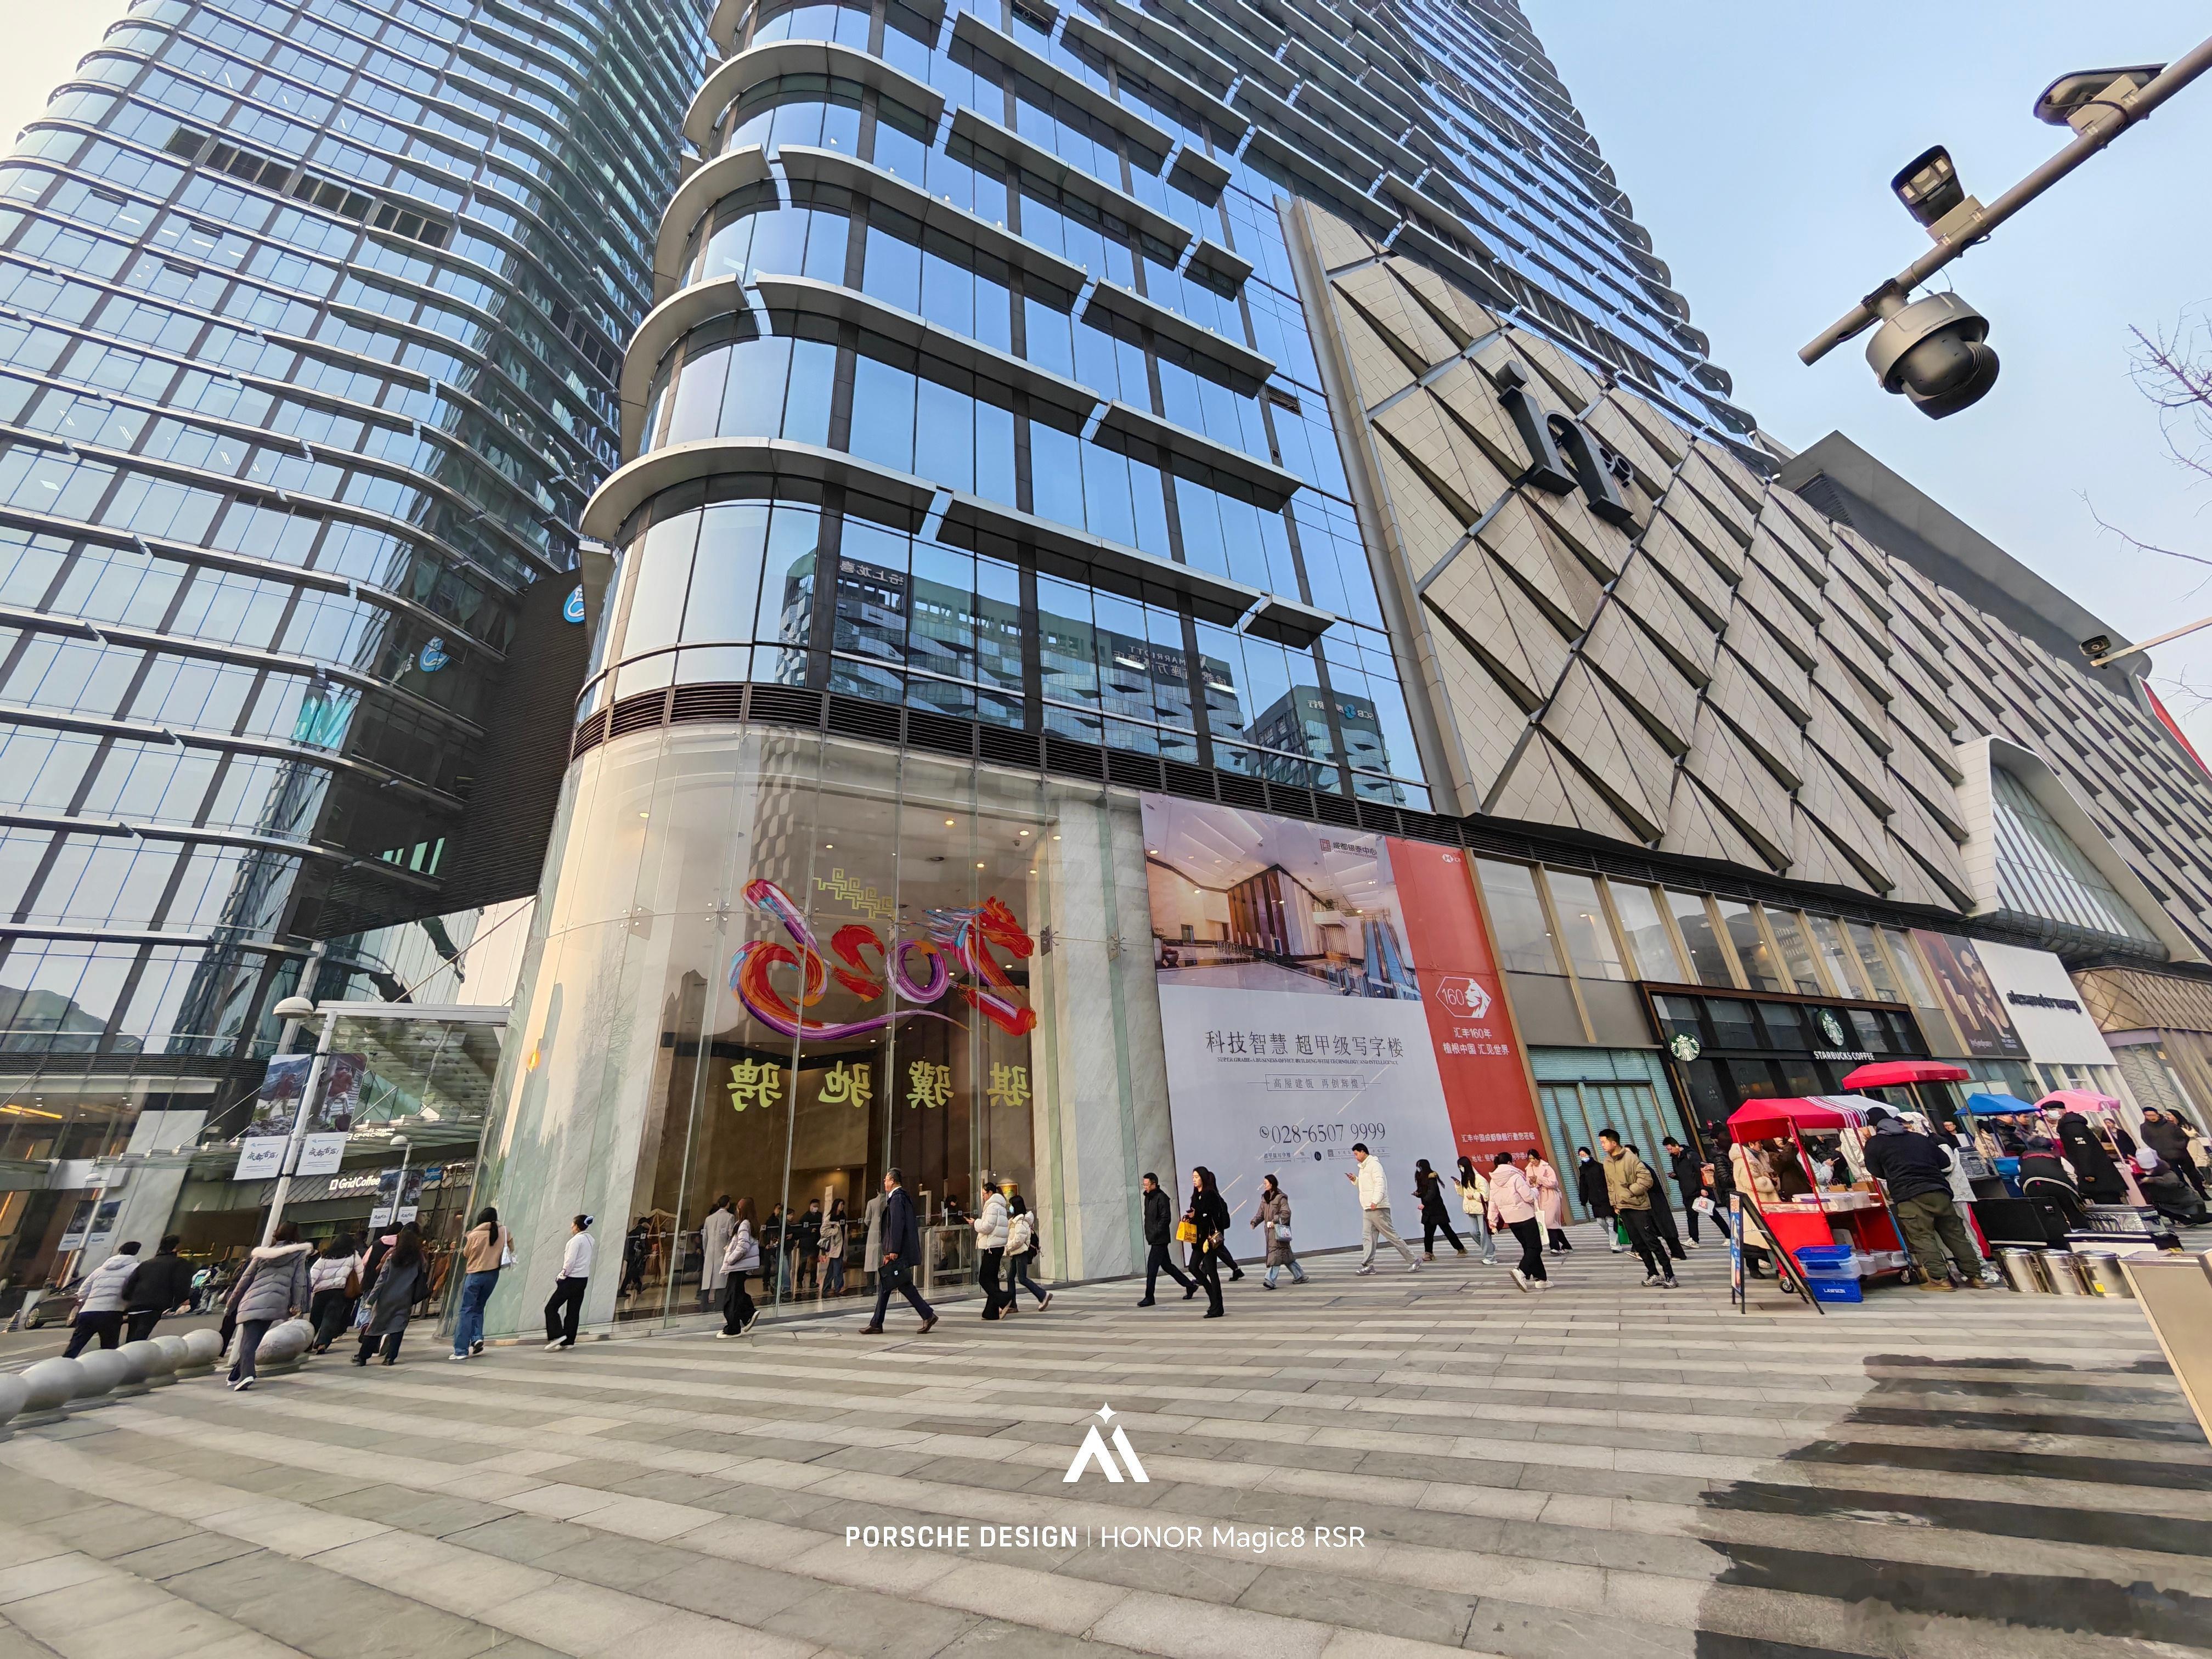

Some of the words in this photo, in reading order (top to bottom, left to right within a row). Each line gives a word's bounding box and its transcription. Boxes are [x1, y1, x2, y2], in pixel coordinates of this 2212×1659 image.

[1442, 988, 1464, 1006] 160
[1453, 1026, 1492, 1039] 汇丰160年
[1205, 1030, 1288, 1054] 科技智慧
[1295, 1034, 1404, 1058] 超甲级写字楼
[1813, 1051, 1852, 1060] STARBUCKS
[1852, 1052, 1875, 1060] COFFEE
[1272, 1124, 1344, 1143] 028-6507
[1350, 1122, 1385, 1141] 9999
